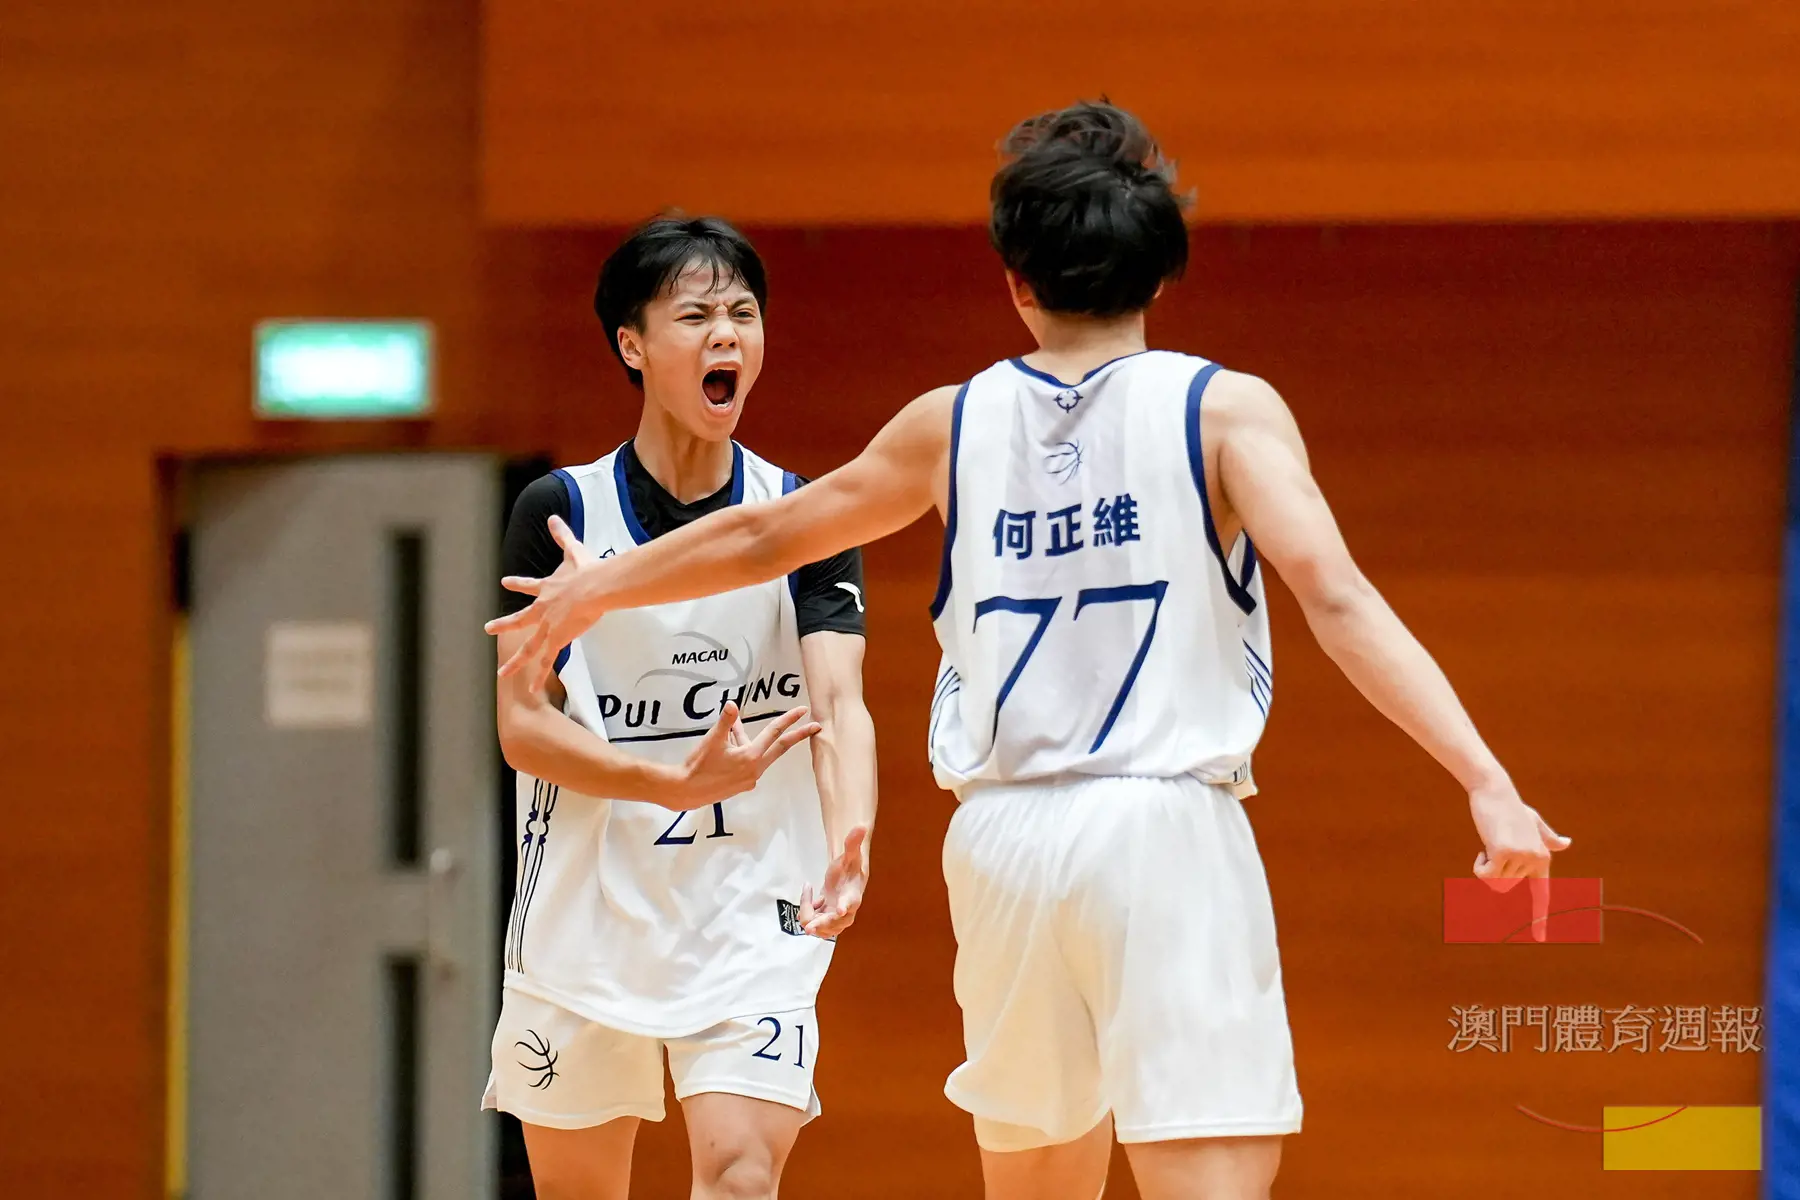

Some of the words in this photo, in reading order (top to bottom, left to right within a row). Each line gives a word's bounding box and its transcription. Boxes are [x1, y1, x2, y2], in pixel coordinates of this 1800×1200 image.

[992, 493, 1141, 560] 何正維
[671, 648, 729, 665] MACAU
[973, 580, 1169, 754] 77
[597, 693, 661, 728] PUI
[752, 1016, 805, 1069] 21
